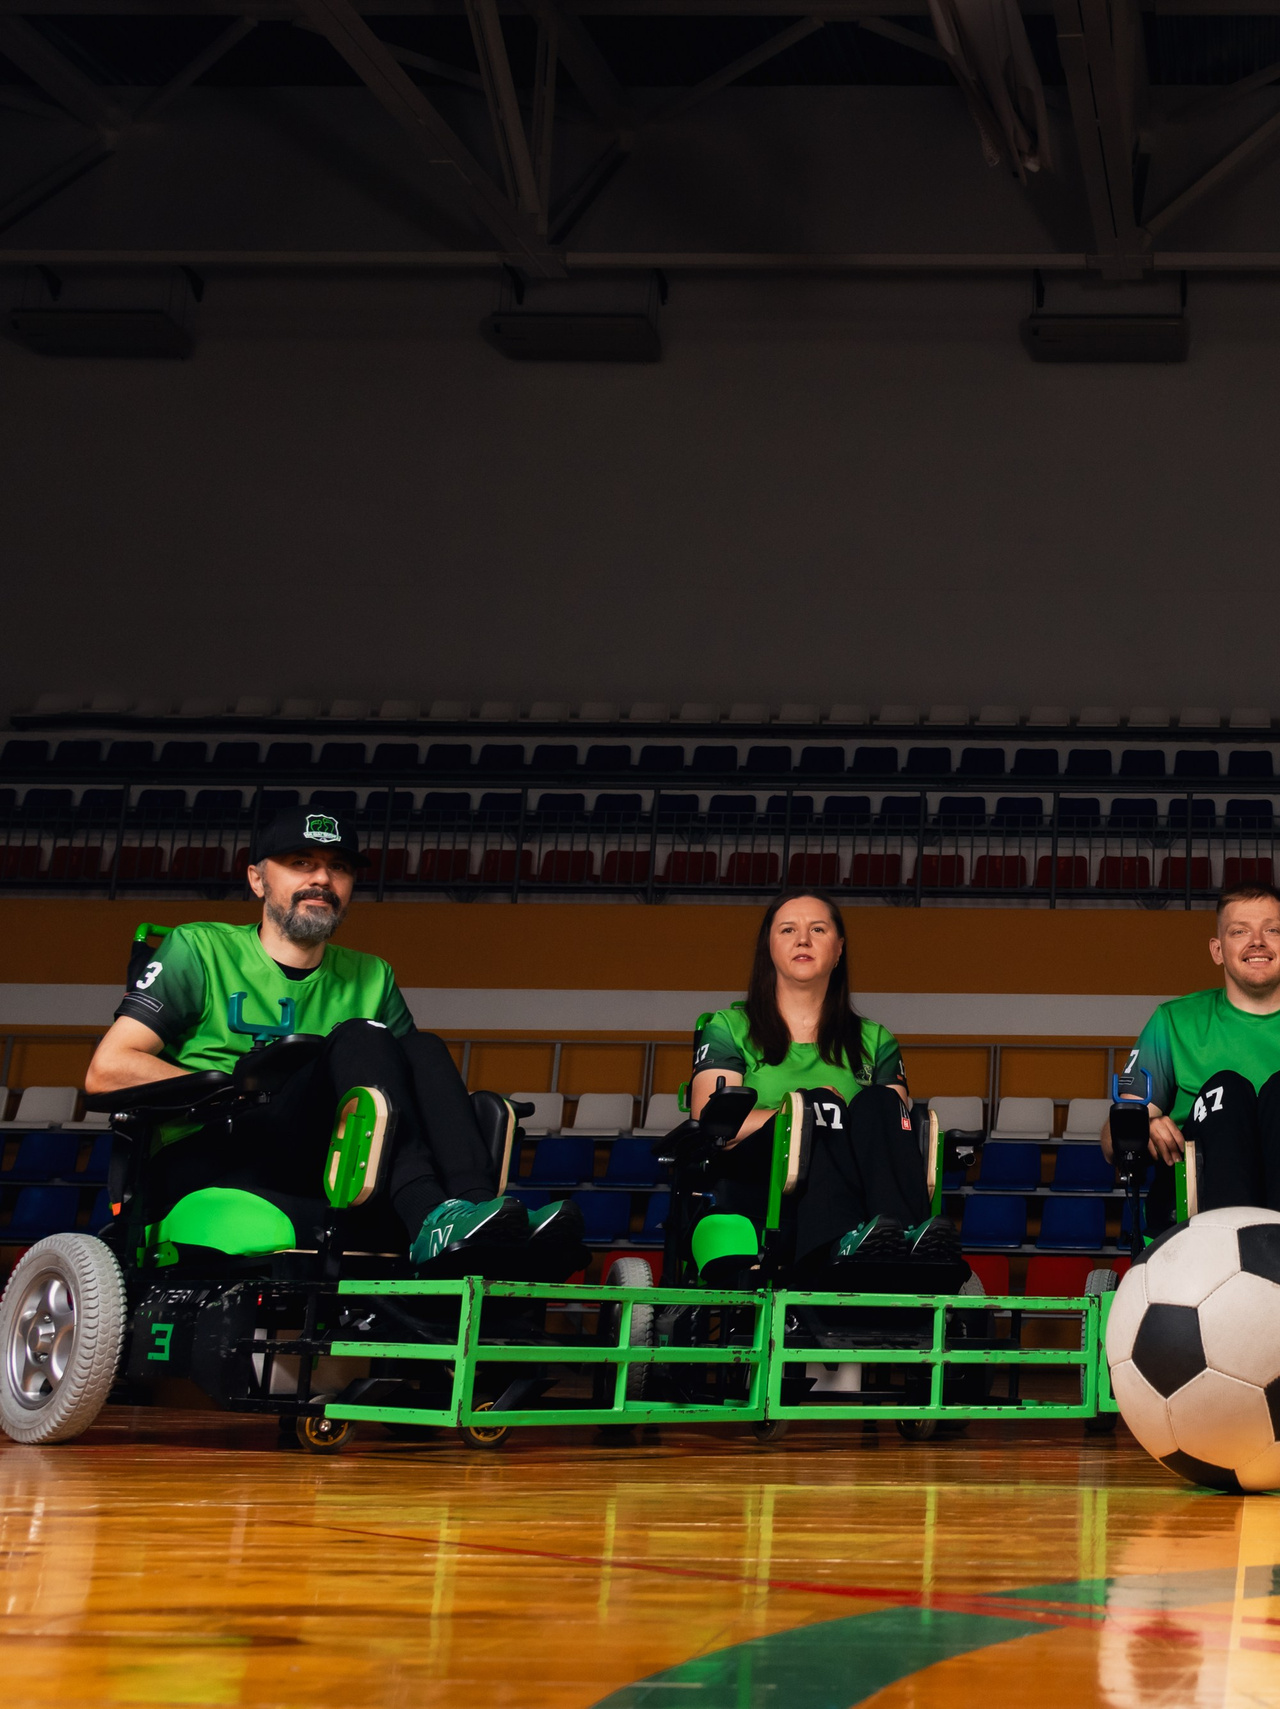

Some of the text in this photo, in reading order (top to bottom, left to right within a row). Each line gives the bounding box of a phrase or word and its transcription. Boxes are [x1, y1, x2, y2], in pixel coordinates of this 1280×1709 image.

[136, 961, 163, 990] 3
[813, 1102, 844, 1130] 17
[1193, 1086, 1224, 1123] 47
[147, 1322, 175, 1362] 3
